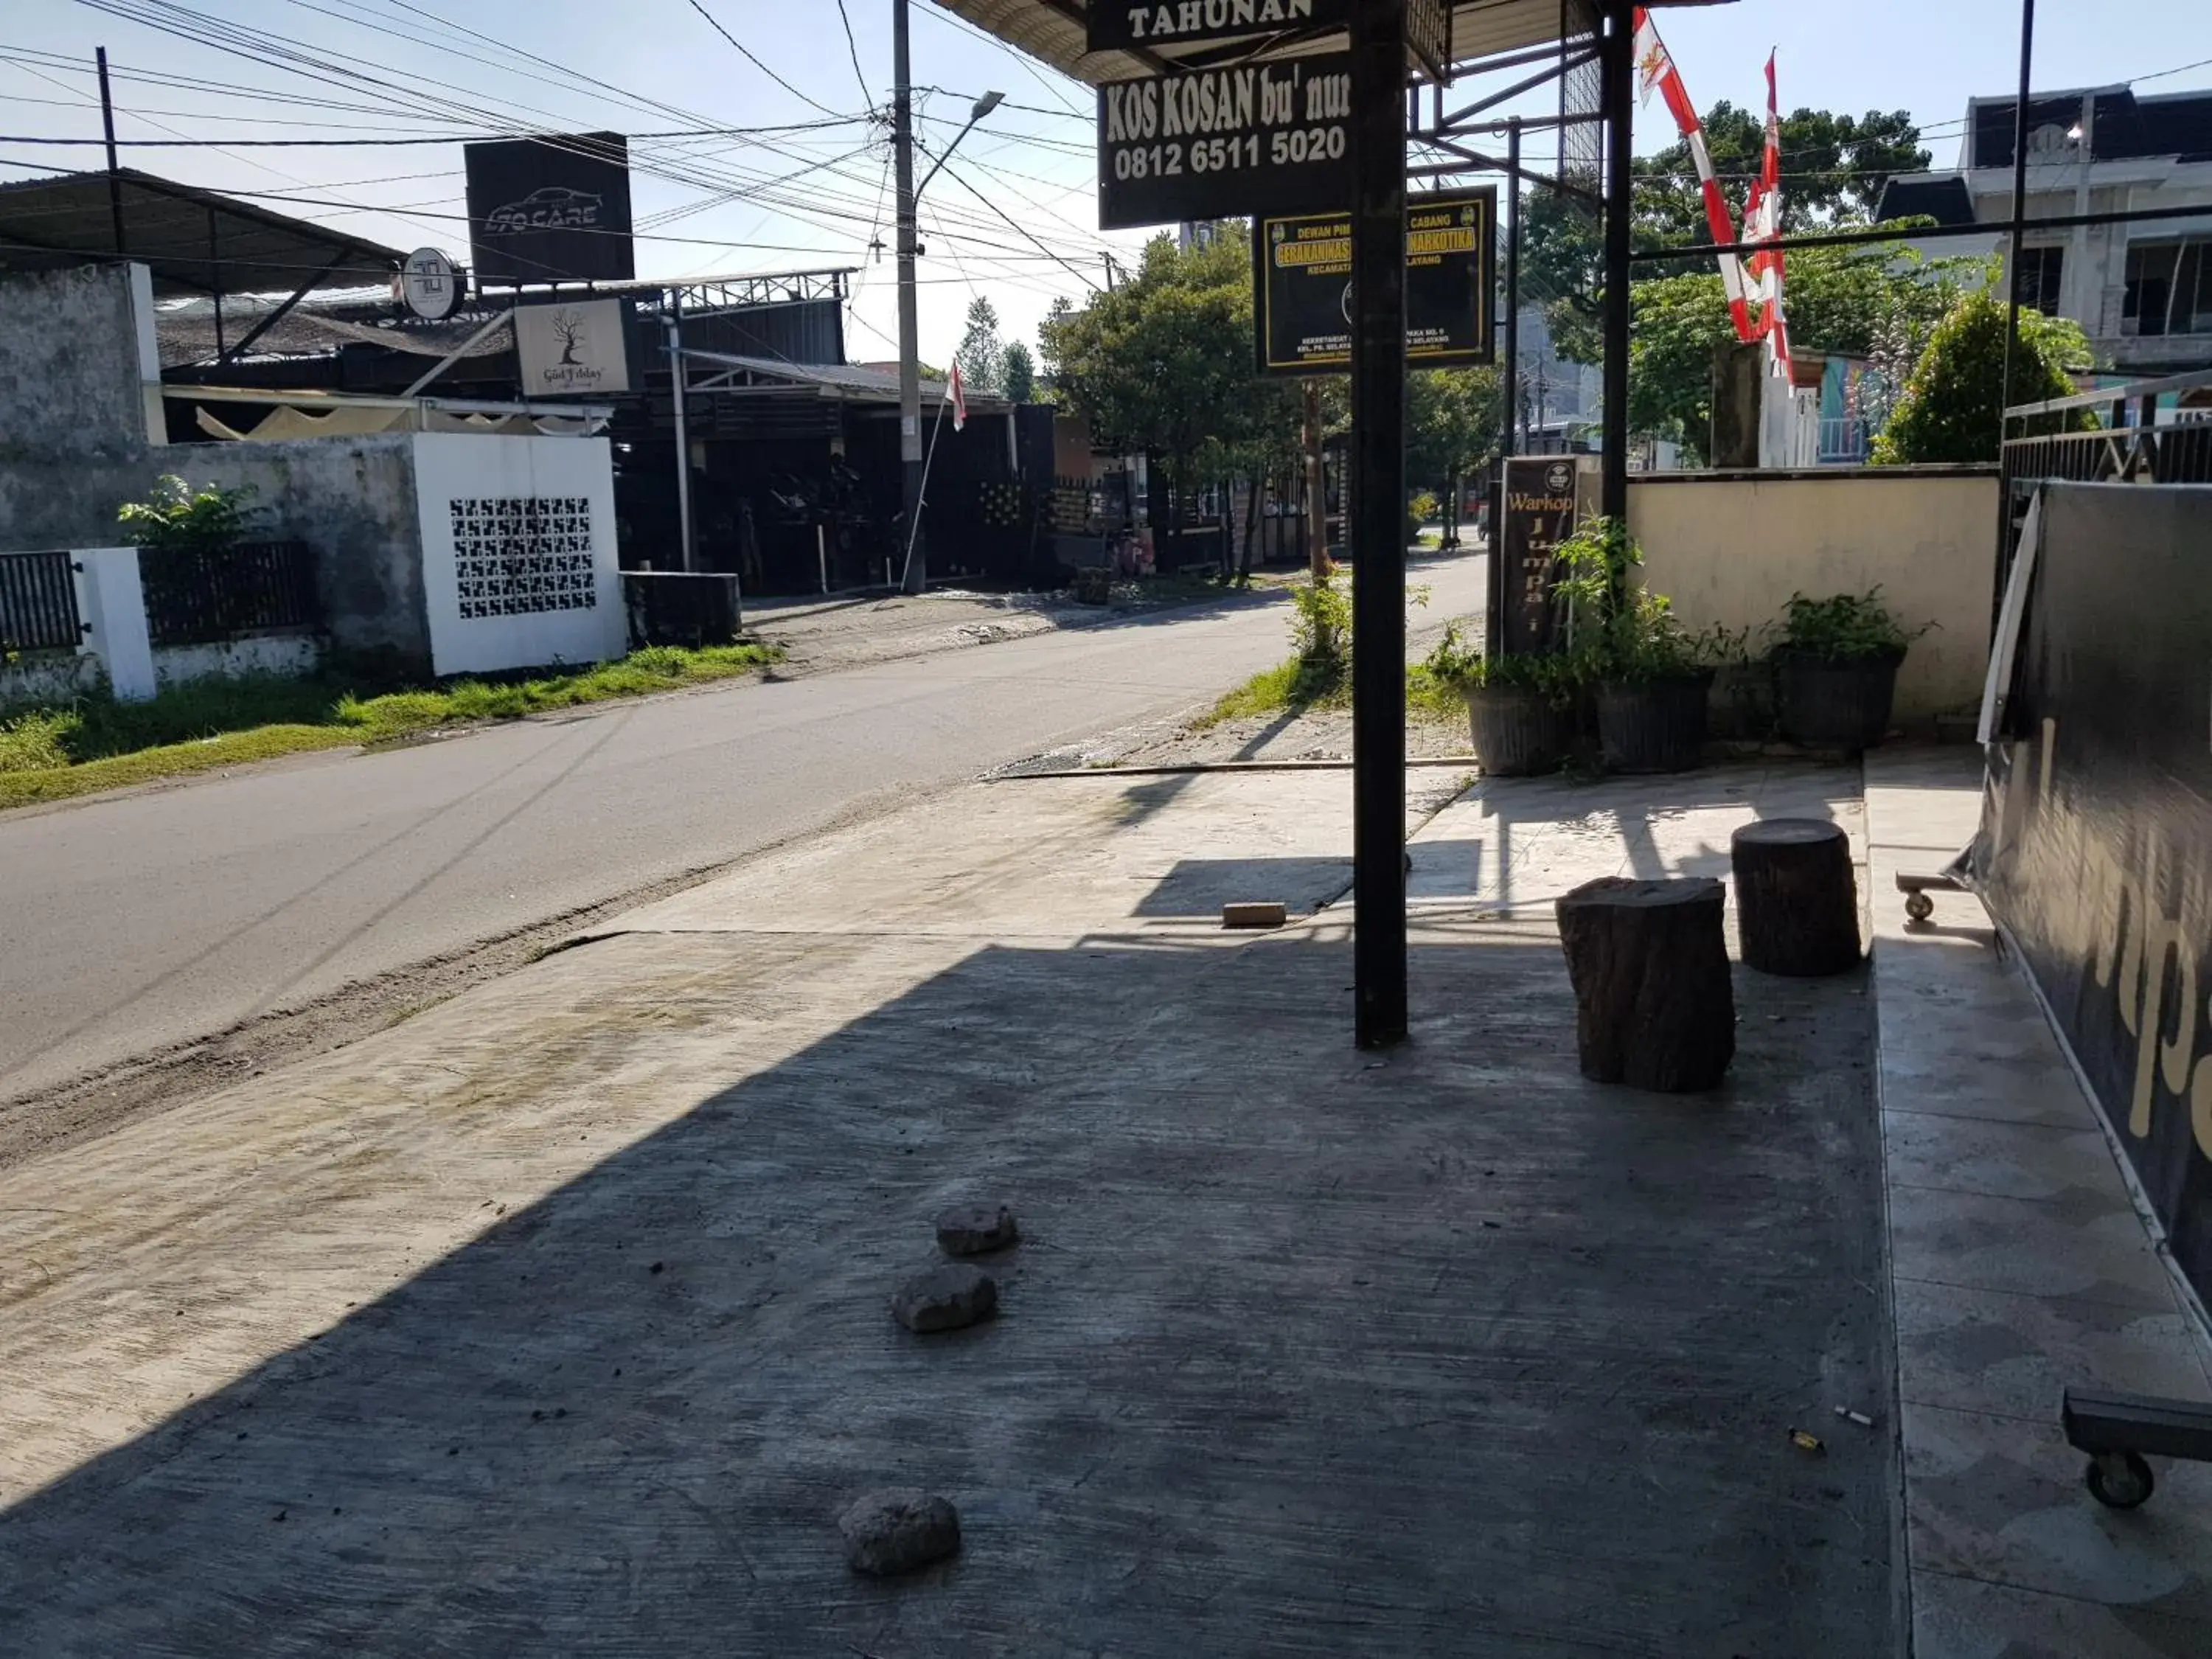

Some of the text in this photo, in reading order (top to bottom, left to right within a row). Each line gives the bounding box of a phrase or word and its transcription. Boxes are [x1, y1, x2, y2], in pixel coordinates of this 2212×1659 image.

[1128, 0, 1312, 38] TAHUNAN
[1107, 82, 1157, 142] KOS
[1162, 67, 1255, 138] KOSAN
[1114, 126, 1346, 181] 0812 6511 5020
[532, 205, 597, 227] CARE
[1411, 213, 1451, 229] CABANG
[1409, 229, 1473, 254] NARKOTIKA
